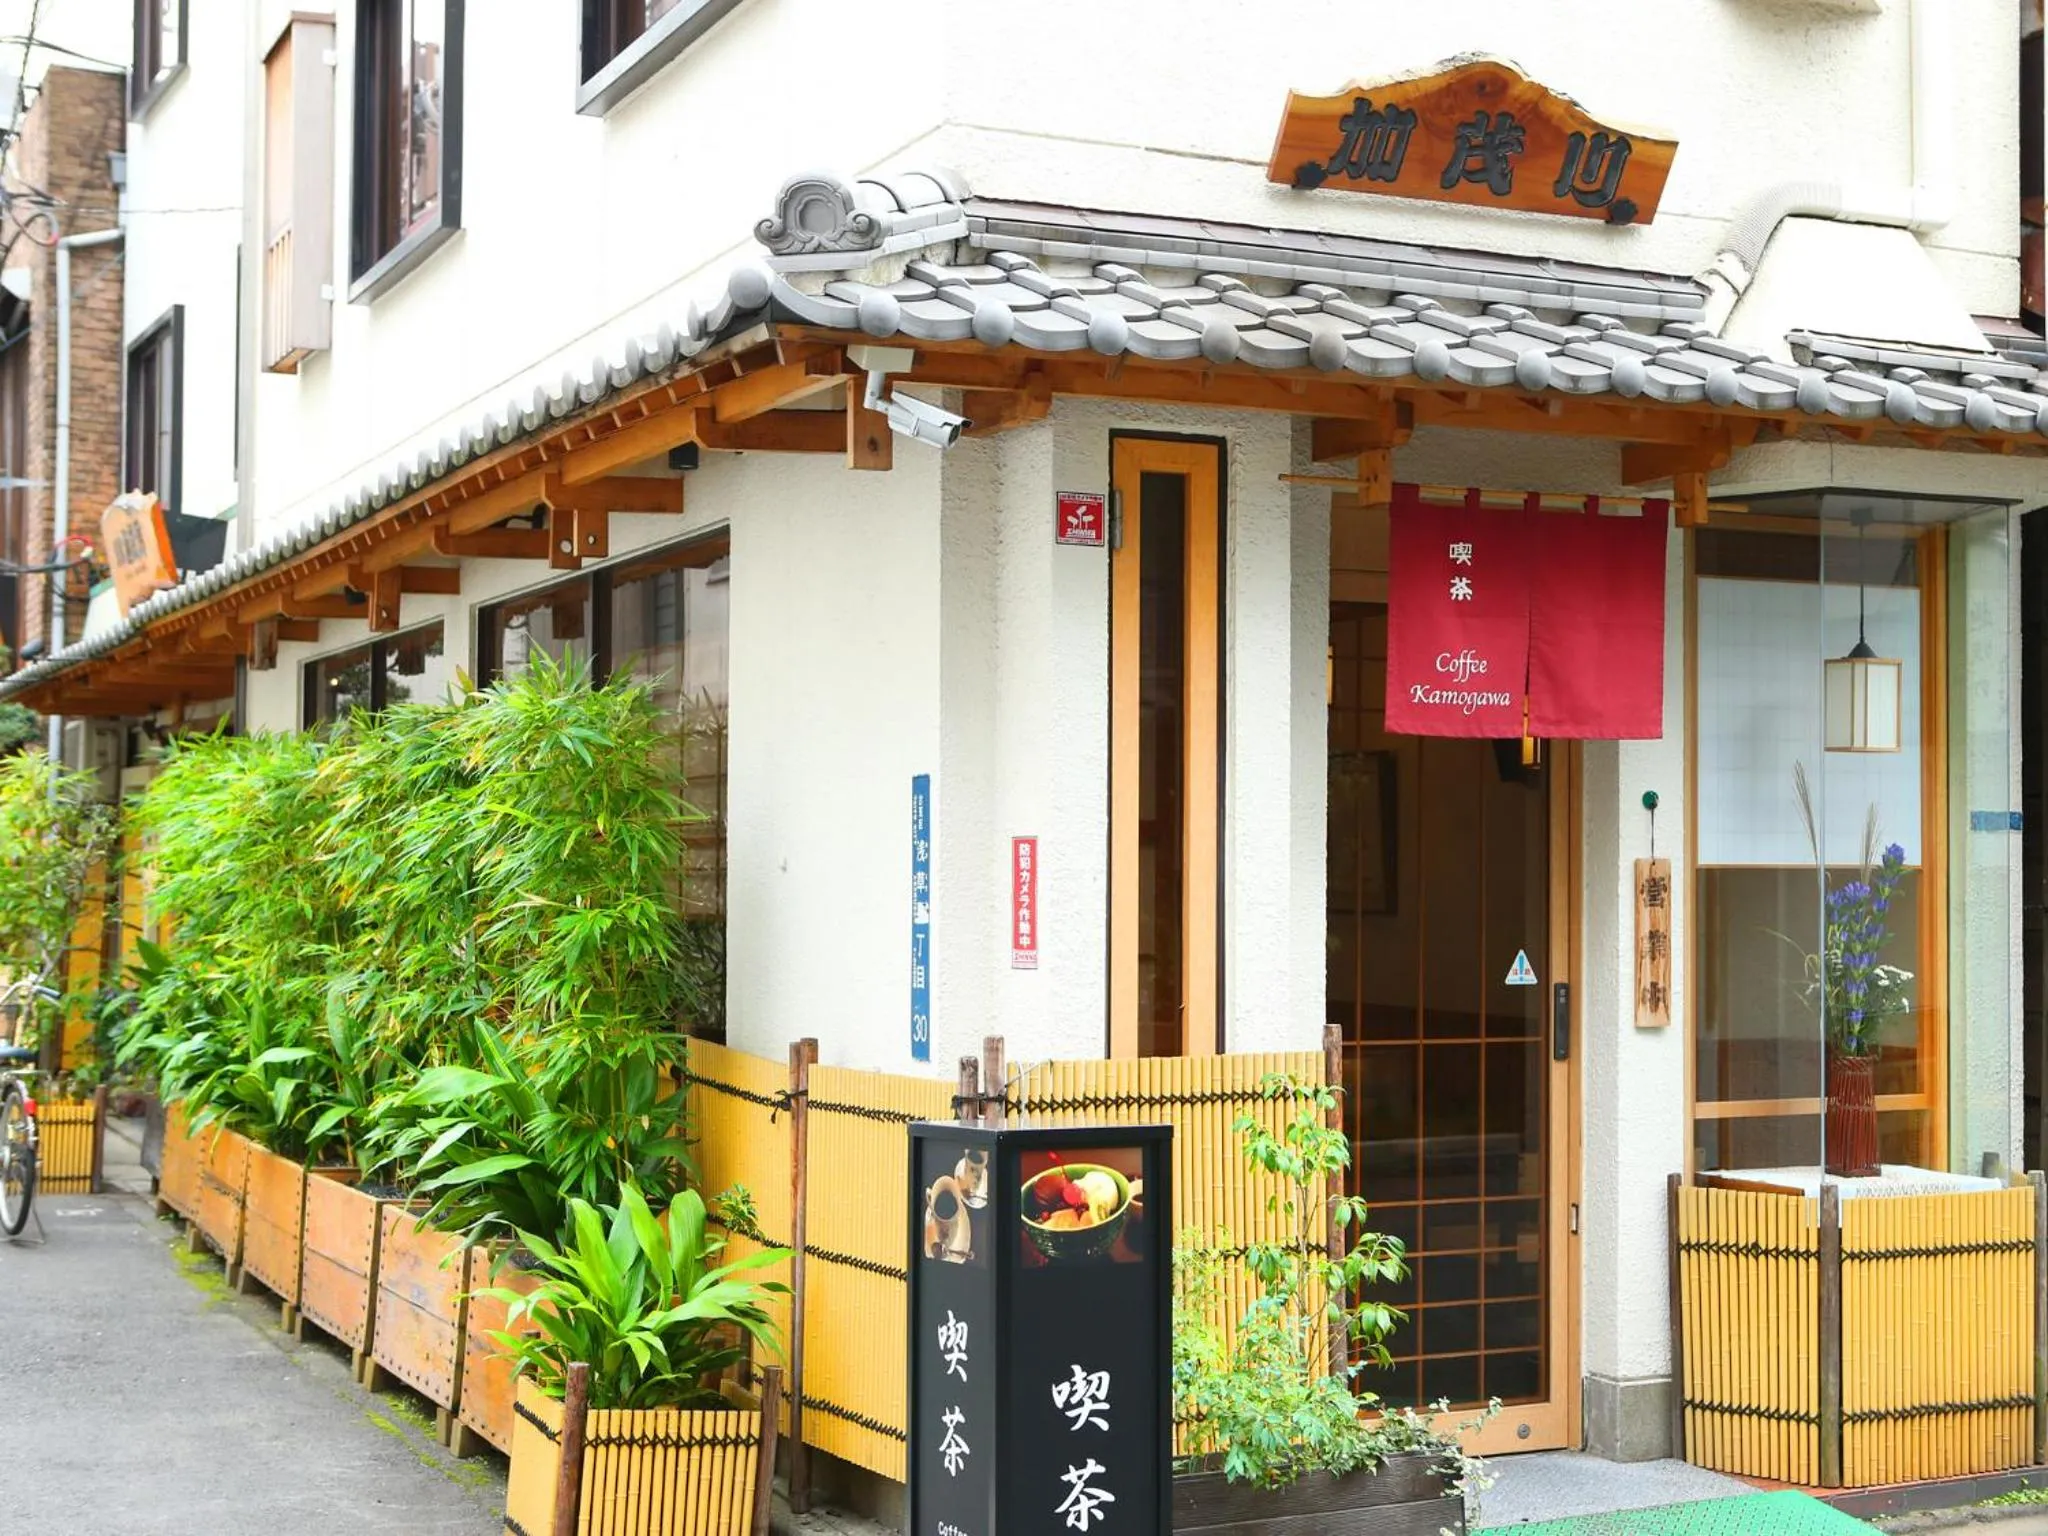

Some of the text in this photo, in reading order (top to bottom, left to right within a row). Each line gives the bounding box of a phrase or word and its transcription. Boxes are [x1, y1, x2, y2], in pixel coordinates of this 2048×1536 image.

[1449, 541, 1473, 601] 喫茶
[1436, 650, 1488, 682] Coffee
[1410, 685, 1511, 715] Kamogawa
[913, 1014, 928, 1042] 30
[937, 1310, 971, 1478] 喫茶
[1051, 1364, 1116, 1533] 喫茶
